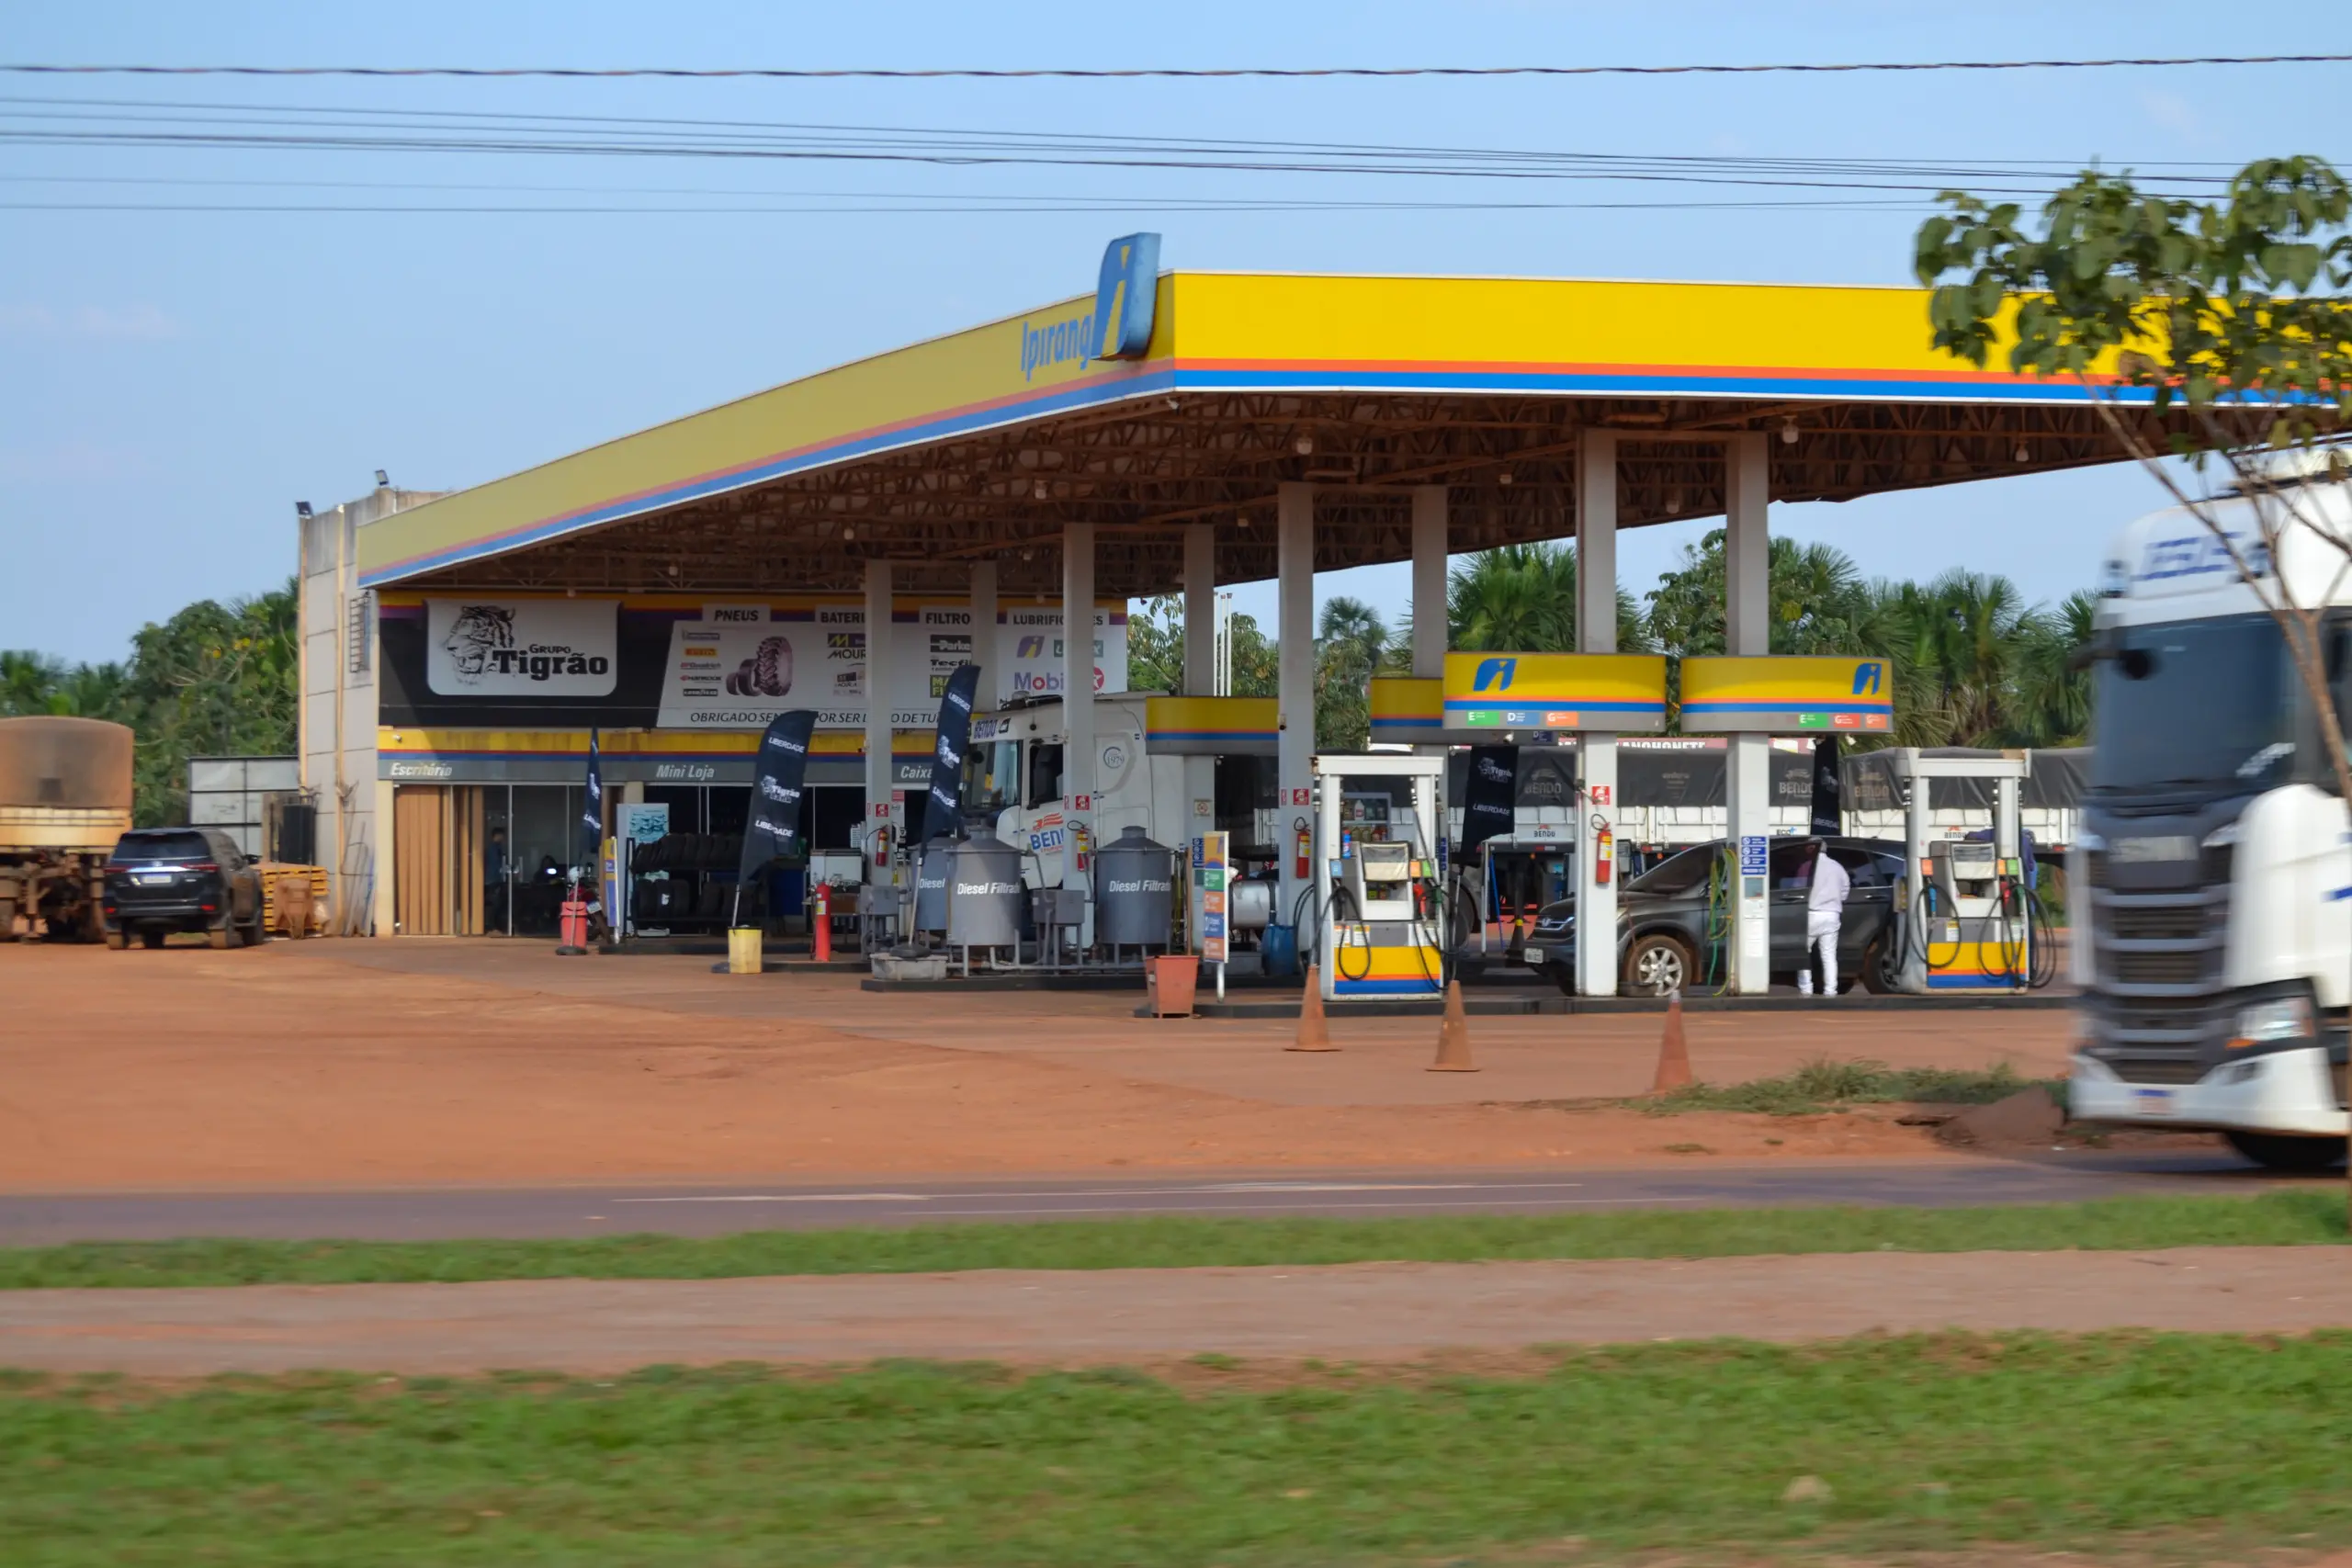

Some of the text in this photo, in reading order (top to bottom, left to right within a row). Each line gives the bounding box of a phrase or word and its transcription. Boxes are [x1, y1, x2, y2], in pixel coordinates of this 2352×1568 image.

[1021, 314, 1093, 382] Ipirang
[714, 609, 759, 622] PNEUS
[820, 612, 865, 624] BATERI
[925, 613, 971, 625] FILTRO
[529, 644, 571, 654] GRUPO
[938, 640, 970, 650] Parke
[827, 649, 865, 660] MOUR
[492, 650, 608, 681] Tigrão
[1014, 671, 1064, 690] Mobi
[690, 712, 757, 723] OBRIGADO
[839, 712, 861, 723] SER
[902, 713, 919, 724] DE
[921, 713, 939, 724] TU
[768, 737, 806, 753] LIBERDADE
[390, 762, 453, 776] Escritório
[656, 764, 715, 782] Mini Loja
[1030, 828, 1064, 851] BEN
[919, 877, 945, 889] Diesel
[957, 882, 989, 896] Diesel
[1109, 879, 1140, 893] Diesel
